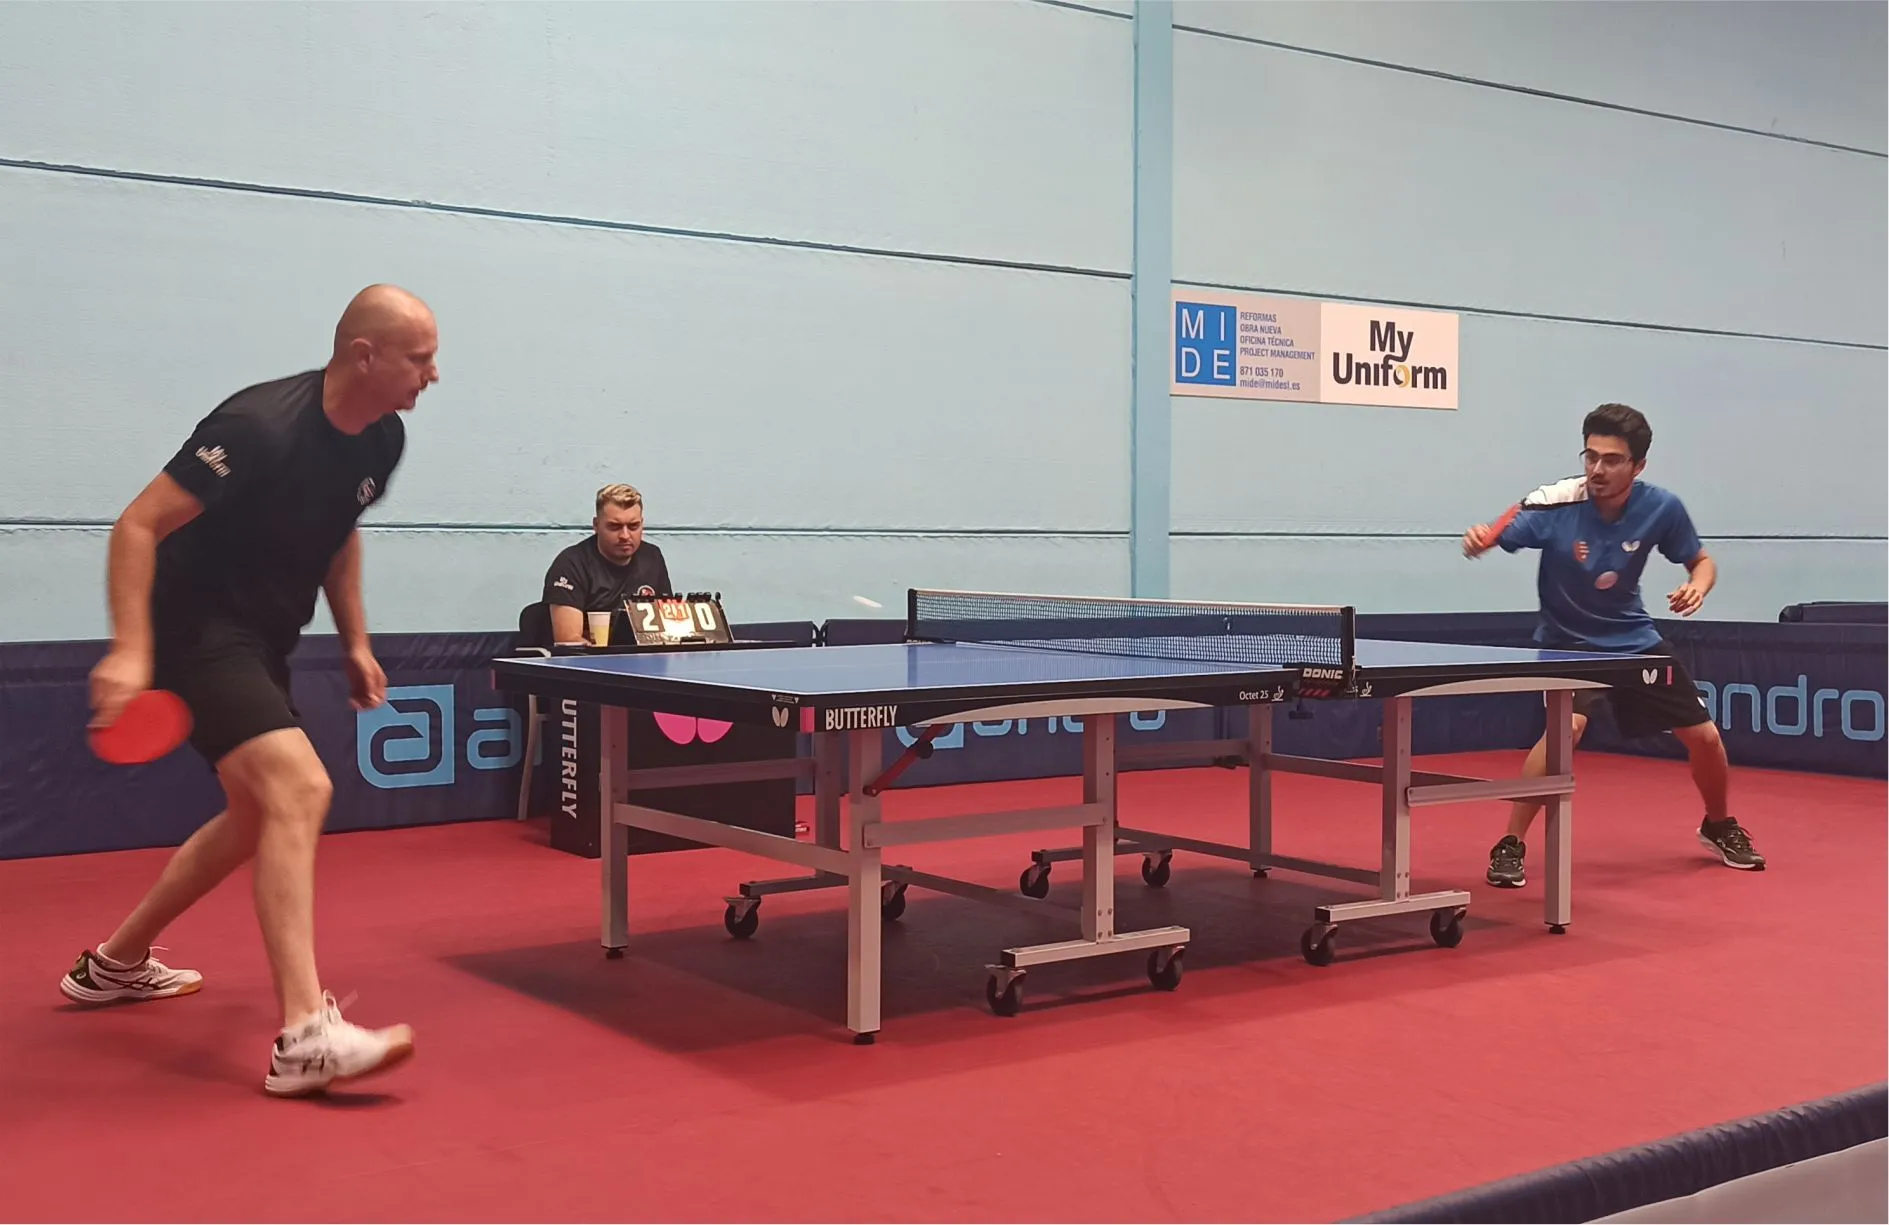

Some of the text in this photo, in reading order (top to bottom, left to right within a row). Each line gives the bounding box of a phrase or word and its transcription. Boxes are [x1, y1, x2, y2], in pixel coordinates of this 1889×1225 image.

[1240, 312, 1277, 323] REFORMAS
[1240, 324, 1282, 335] OBRA NUEVA
[1240, 336, 1294, 348] OFICINA TÉCNICA
[1370, 320, 1414, 363] My
[1240, 347, 1315, 360] PROJECT MANAGEMENT
[1240, 366, 1284, 378] 871 035 170
[1333, 352, 1447, 390] Uniform
[636, 602, 660, 632] 2
[1302, 667, 1344, 680] DONIC
[1239, 689, 1269, 701] Octet 25
[825, 704, 898, 731] BUTTERFLY
[561, 698, 577, 820] UTTERFLY
